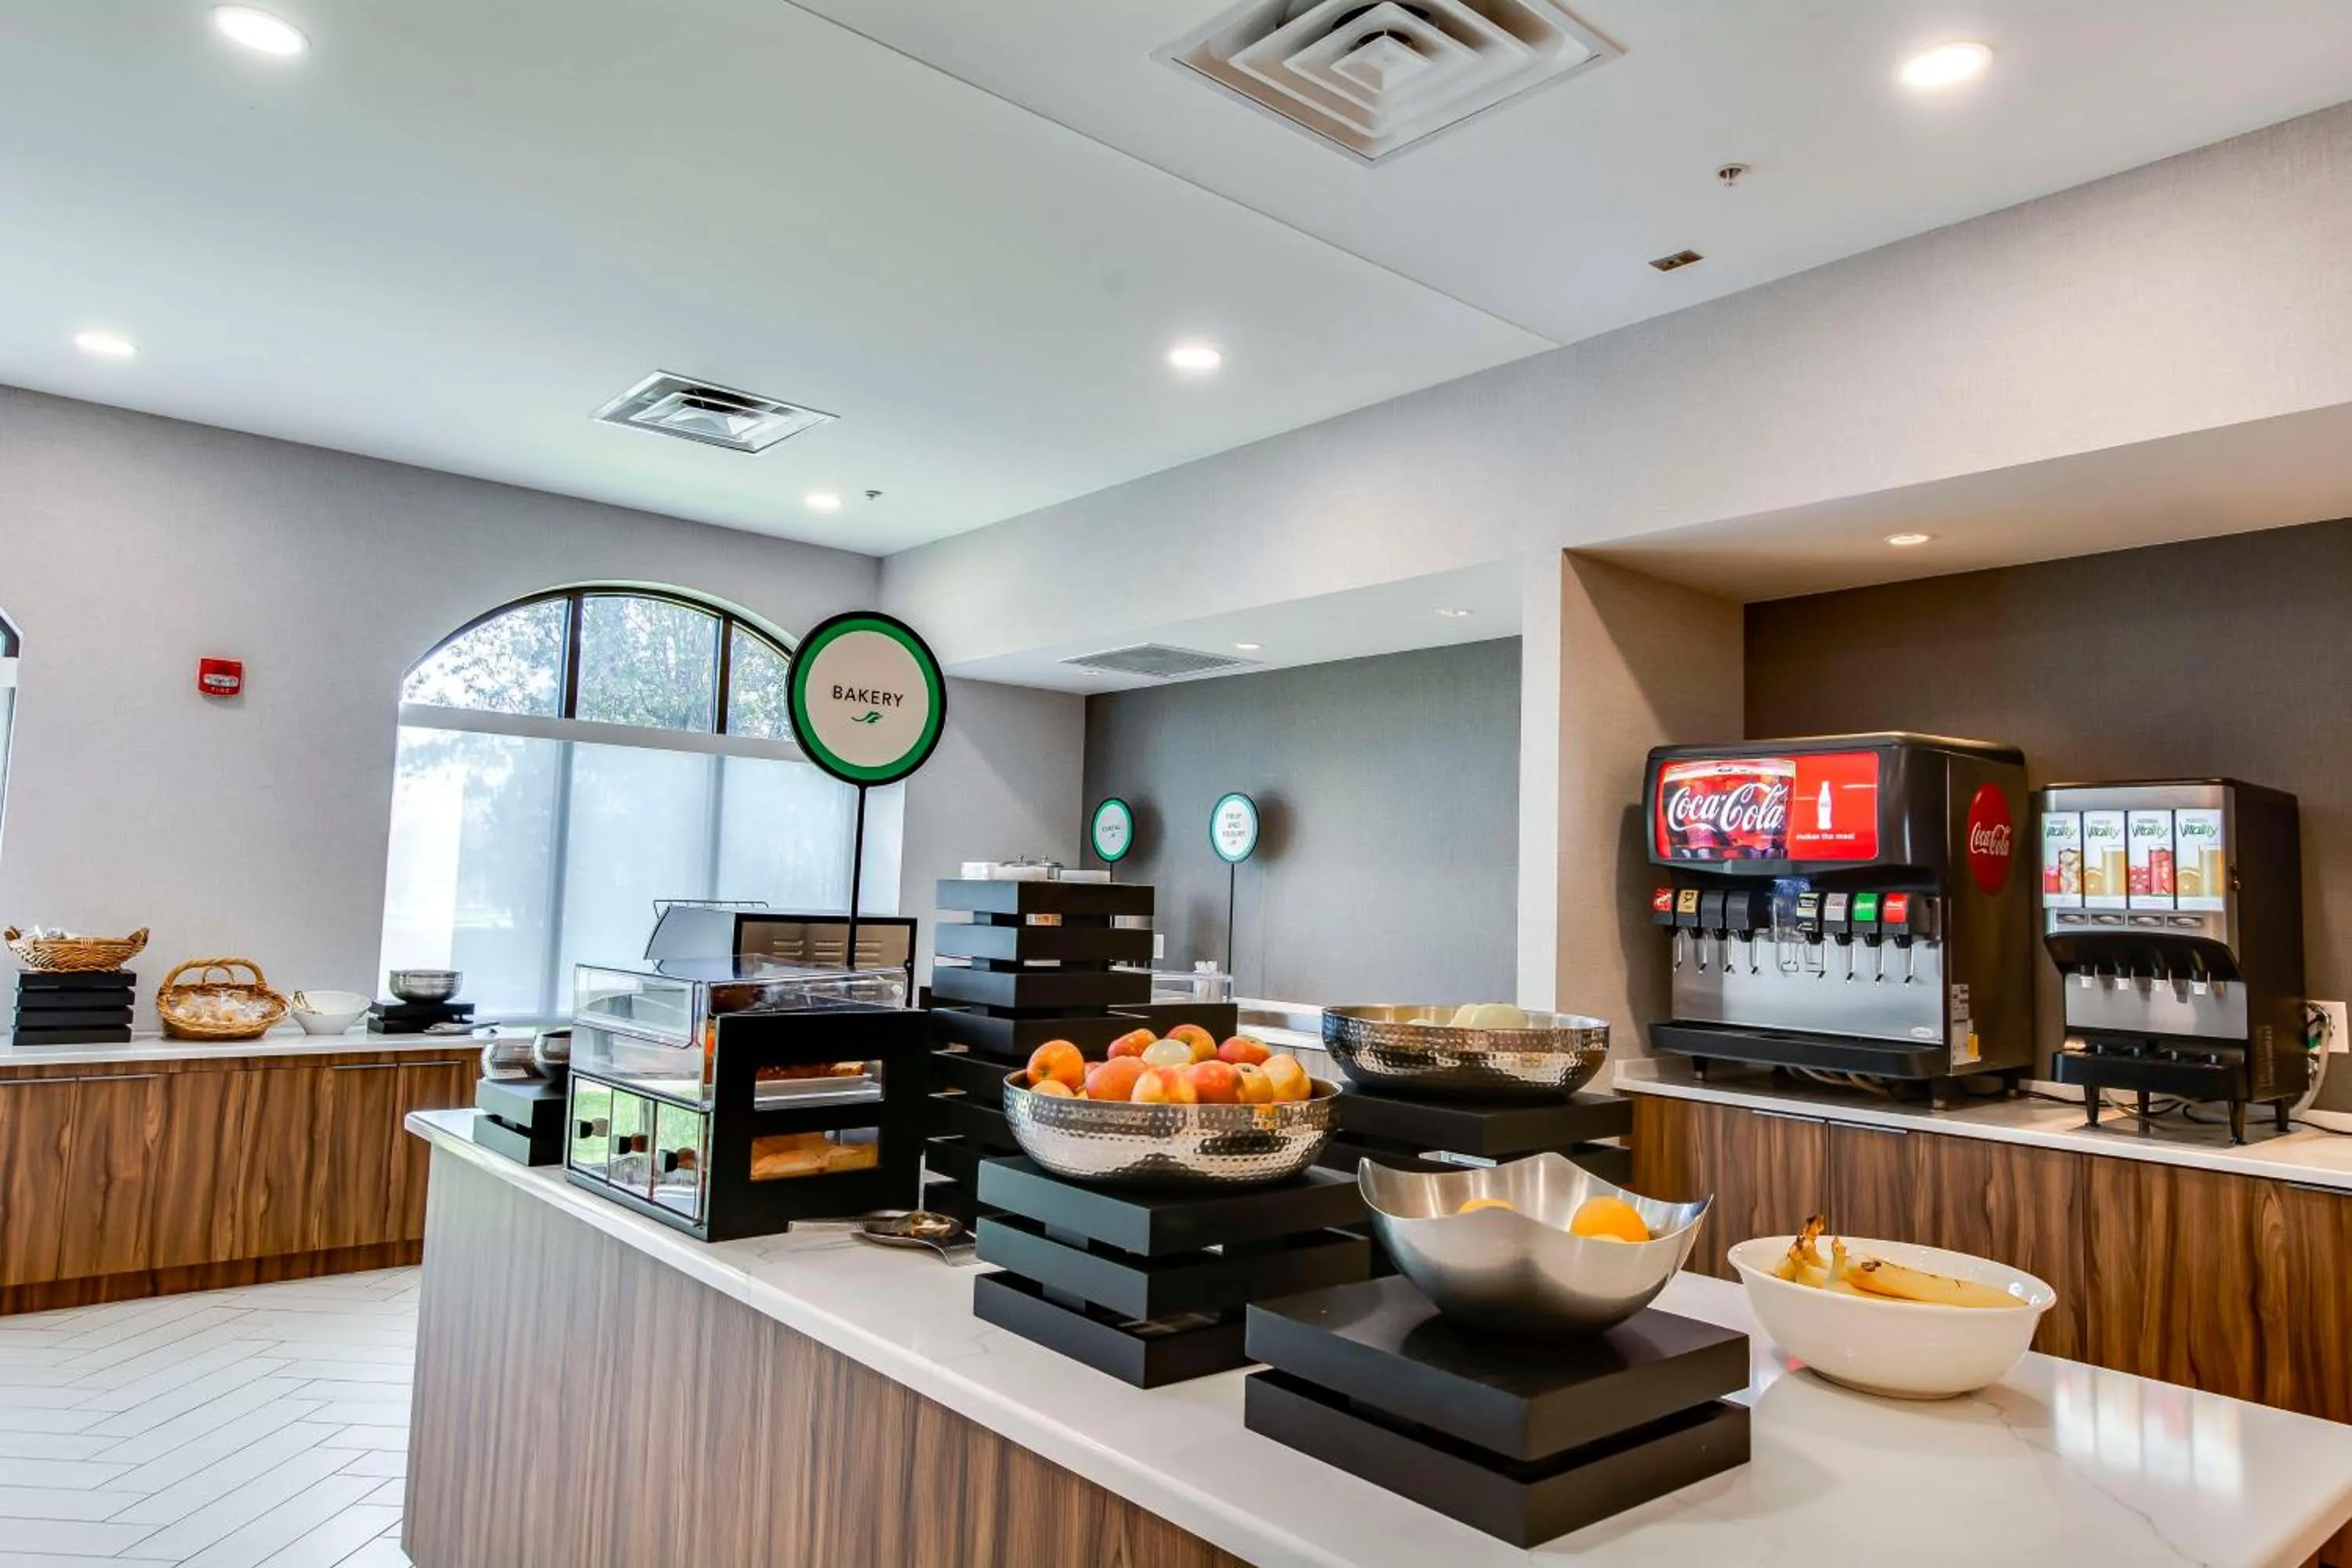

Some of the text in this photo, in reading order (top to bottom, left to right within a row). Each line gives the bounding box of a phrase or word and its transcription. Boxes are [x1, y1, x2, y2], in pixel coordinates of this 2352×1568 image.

[832, 684, 904, 708] BAKERY
[1668, 782, 1789, 833] Coca-Cola
[1970, 821, 2012, 856] Coca-Cola
